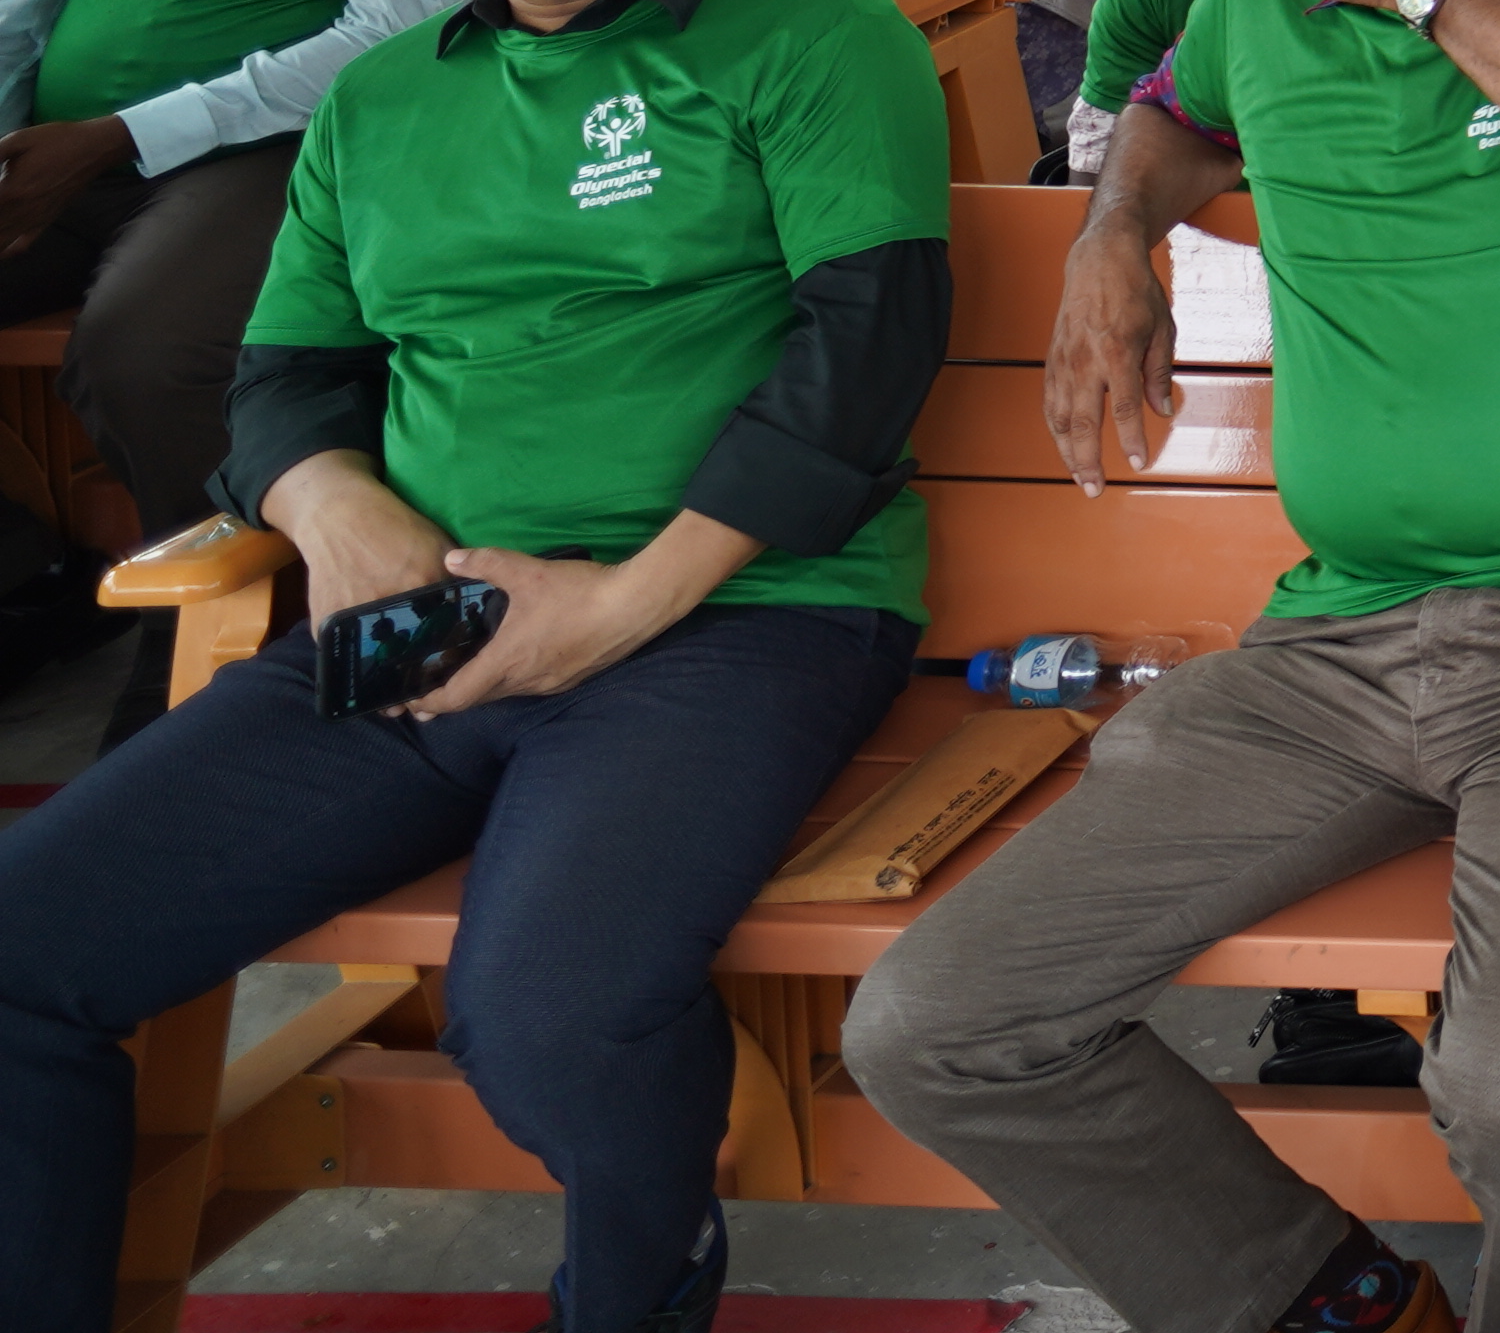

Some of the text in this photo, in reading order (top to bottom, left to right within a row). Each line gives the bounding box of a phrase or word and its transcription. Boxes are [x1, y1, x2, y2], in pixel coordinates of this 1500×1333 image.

[579, 151, 653, 179] Special
[570, 167, 662, 196] Olympics
[579, 184, 653, 209] Bangladesh
